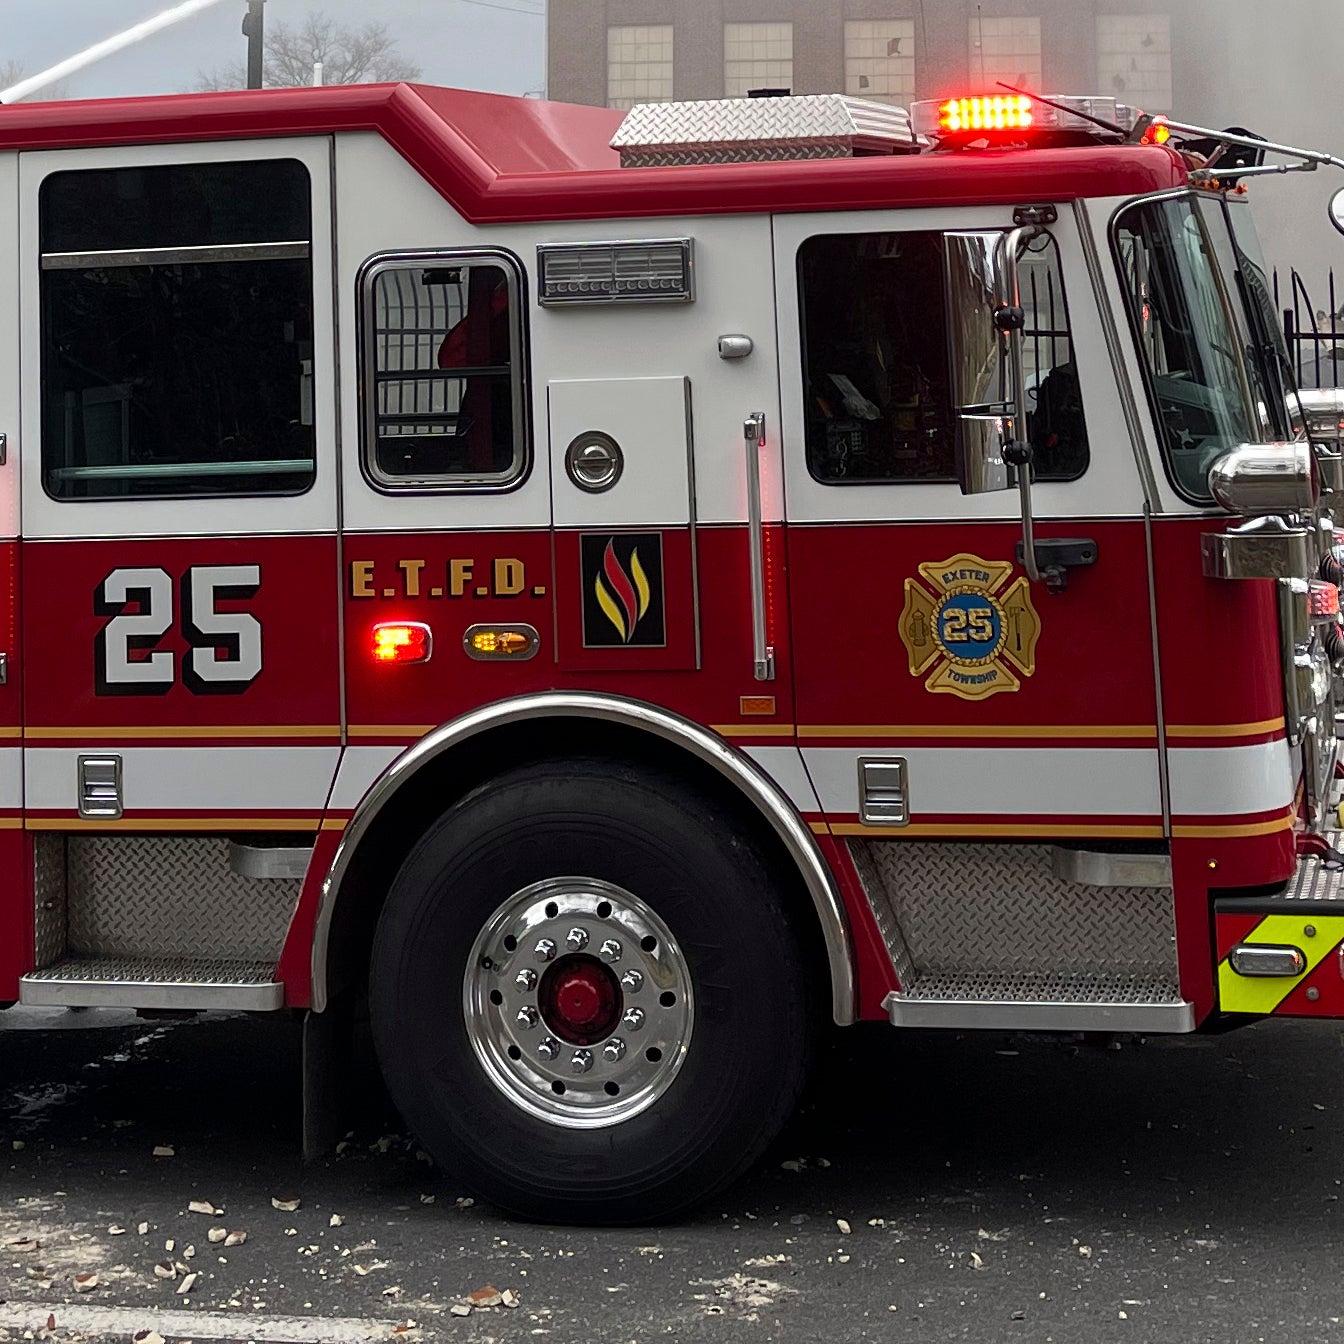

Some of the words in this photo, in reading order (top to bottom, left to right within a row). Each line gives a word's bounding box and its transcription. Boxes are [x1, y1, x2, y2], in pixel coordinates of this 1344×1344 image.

[352, 558, 546, 598] E.T.F.D.
[941, 568, 991, 585] EXETER
[102, 564, 263, 685] 25
[942, 607, 994, 642] 25
[947, 668, 998, 685] TOWNSHIP
